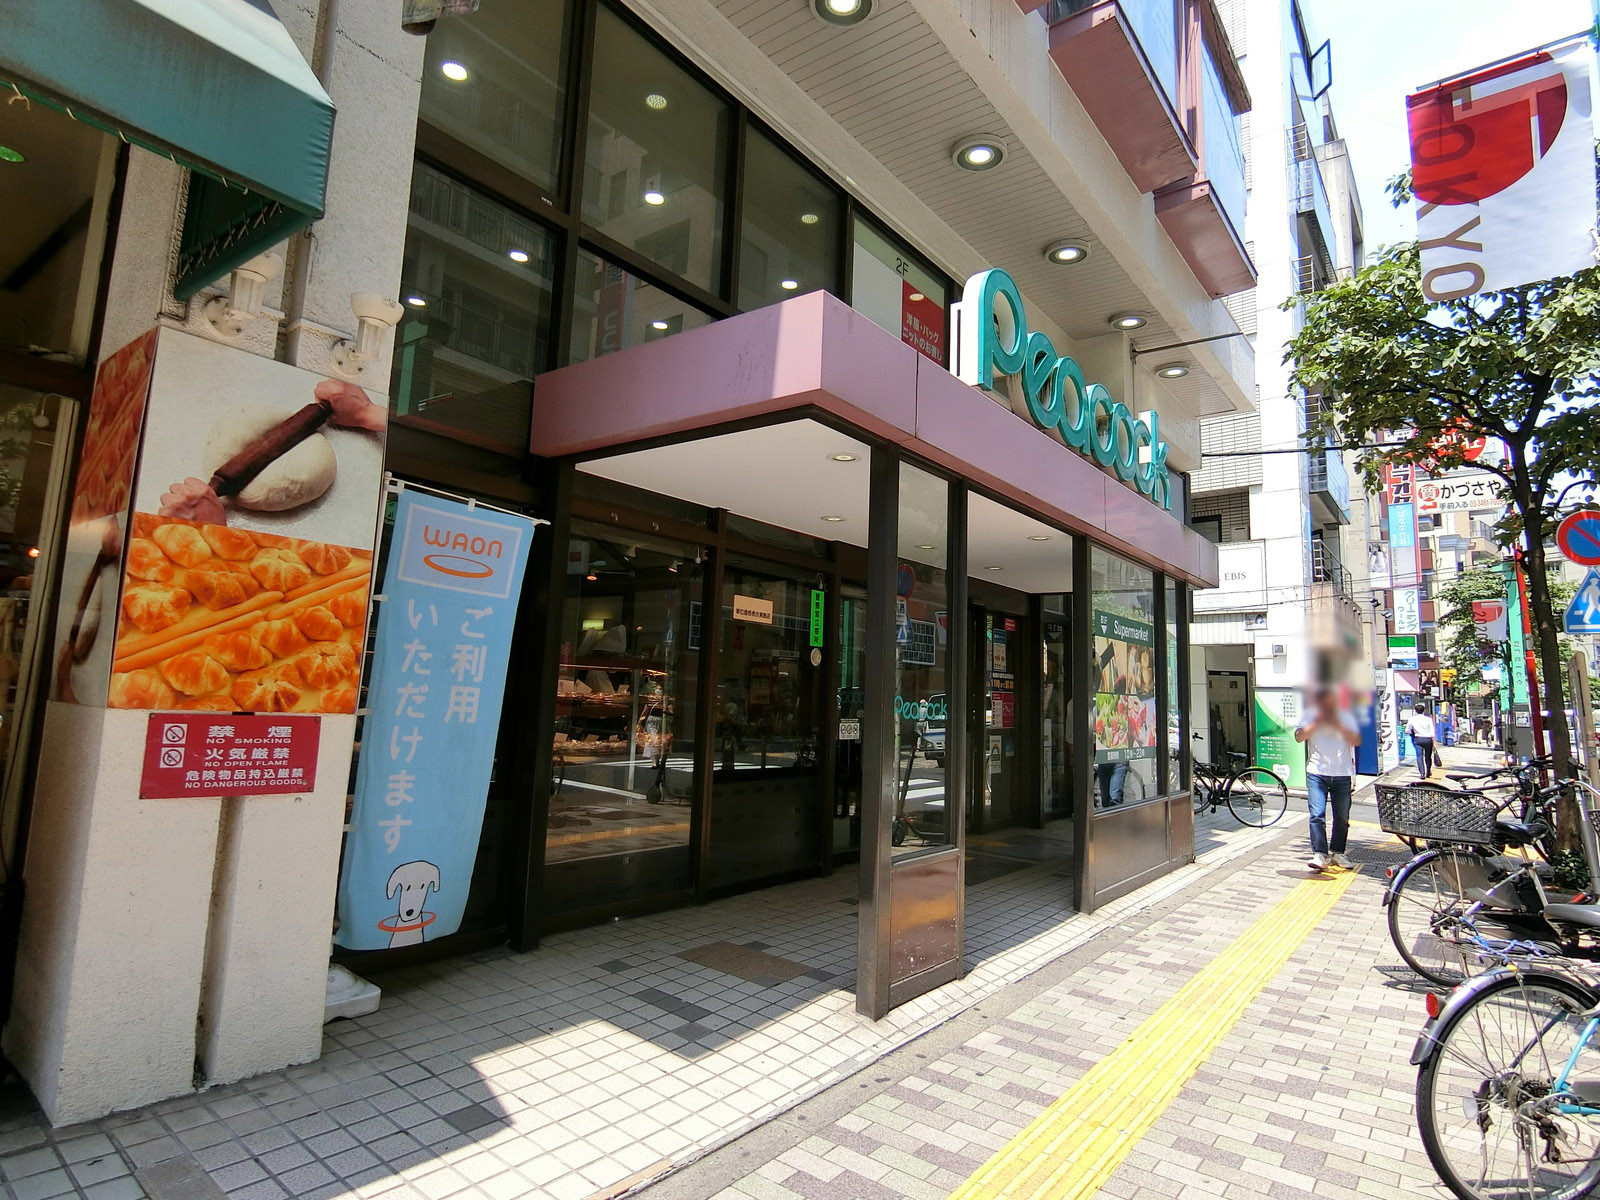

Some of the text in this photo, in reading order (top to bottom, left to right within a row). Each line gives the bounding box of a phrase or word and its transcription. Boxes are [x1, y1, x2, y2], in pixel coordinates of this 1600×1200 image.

[896, 258, 909, 276] 2F
[970, 268, 1171, 511] Peacock
[1441, 479, 1502, 499] かづさや
[1439, 501, 1468, 510] 手前入る
[423, 525, 503, 559] WAON
[1405, 590, 1417, 632] クリーニング
[1114, 620, 1148, 641] Supermarket
[444, 606, 494, 723] ご利用
[894, 695, 947, 720] Peacock
[208, 725, 292, 738] 禁煙
[378, 599, 439, 854] いただけます
[204, 747, 290, 760] 火気厳禁
[185, 768, 304, 781] 危険物品持込厳禁
[204, 780, 267, 788] DANGEROUS
